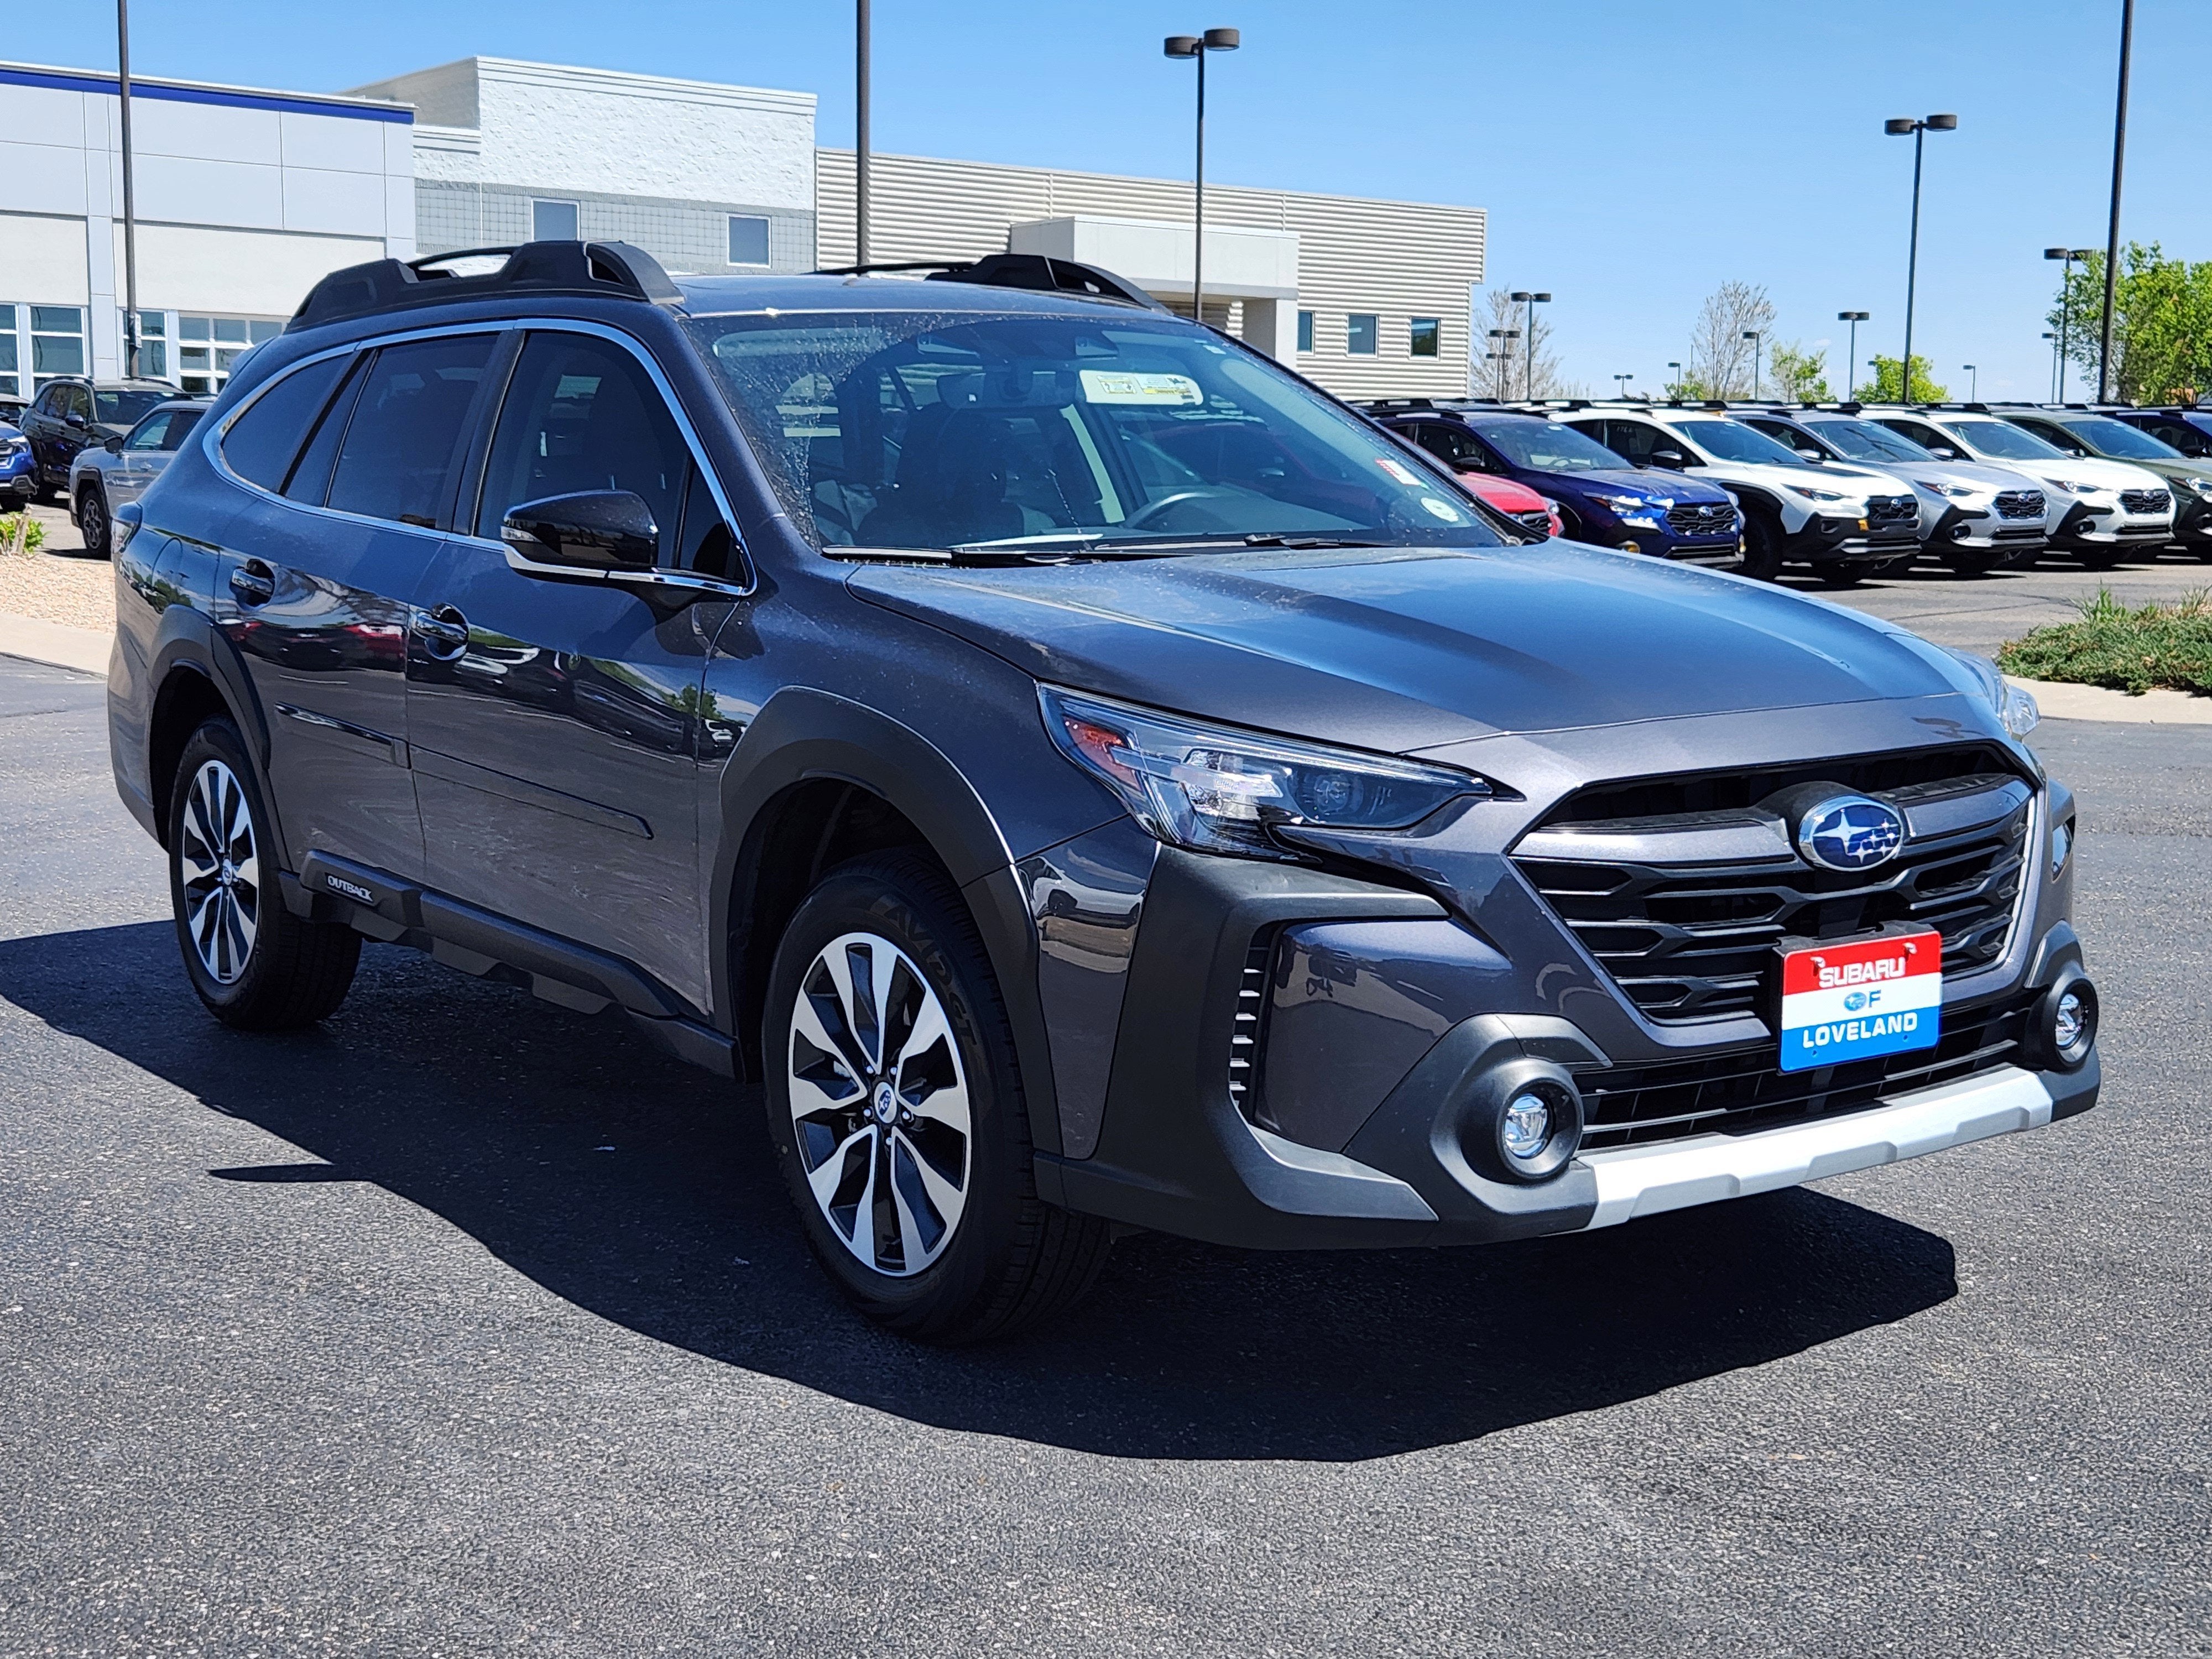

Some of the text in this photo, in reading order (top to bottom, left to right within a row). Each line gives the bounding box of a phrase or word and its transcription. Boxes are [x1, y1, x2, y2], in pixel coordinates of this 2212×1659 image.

[327, 875, 373, 902] OUTBACK
[1819, 957, 1906, 988] SUBARU
[1803, 1012, 1918, 1048] LOVELAND
